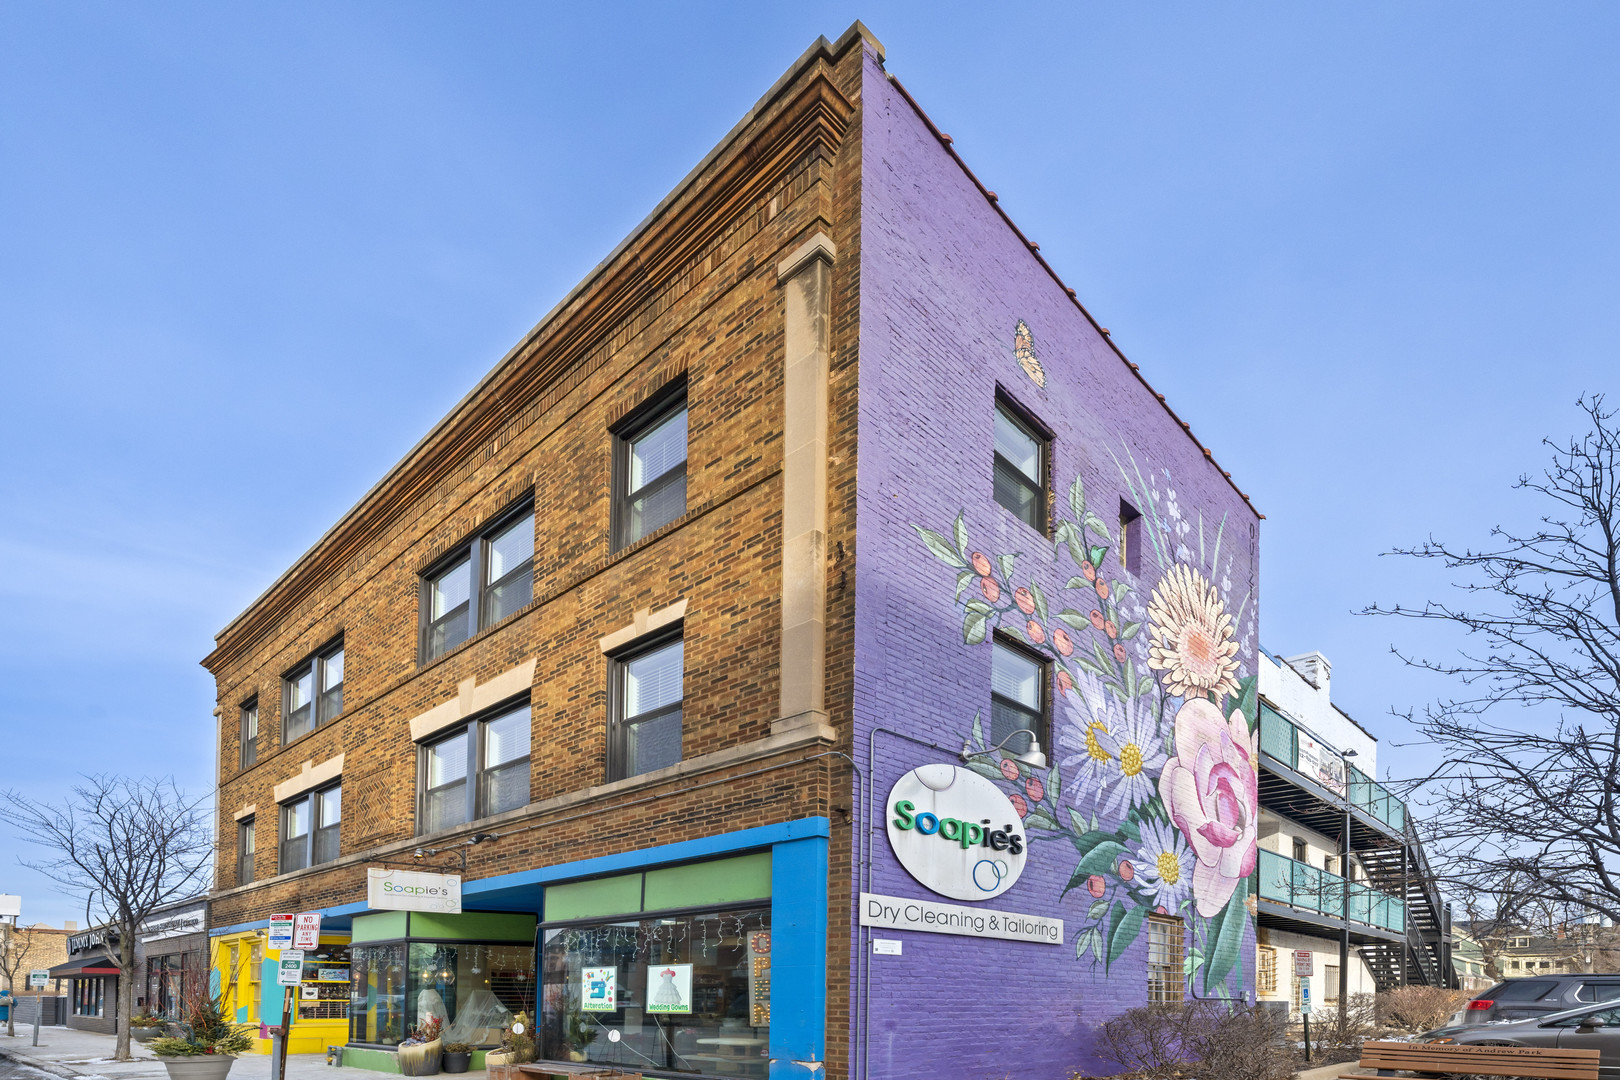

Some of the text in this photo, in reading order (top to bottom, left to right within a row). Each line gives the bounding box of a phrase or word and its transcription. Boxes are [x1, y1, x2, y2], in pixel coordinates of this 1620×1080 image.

[893, 799, 1023, 855] Soapie's
[383, 881, 448, 896] Soapie's
[868, 900, 1058, 940] Dry Cleaning & Tailoring
[751, 932, 771, 1025] OPEN
[649, 1003, 670, 1011] Wedding
